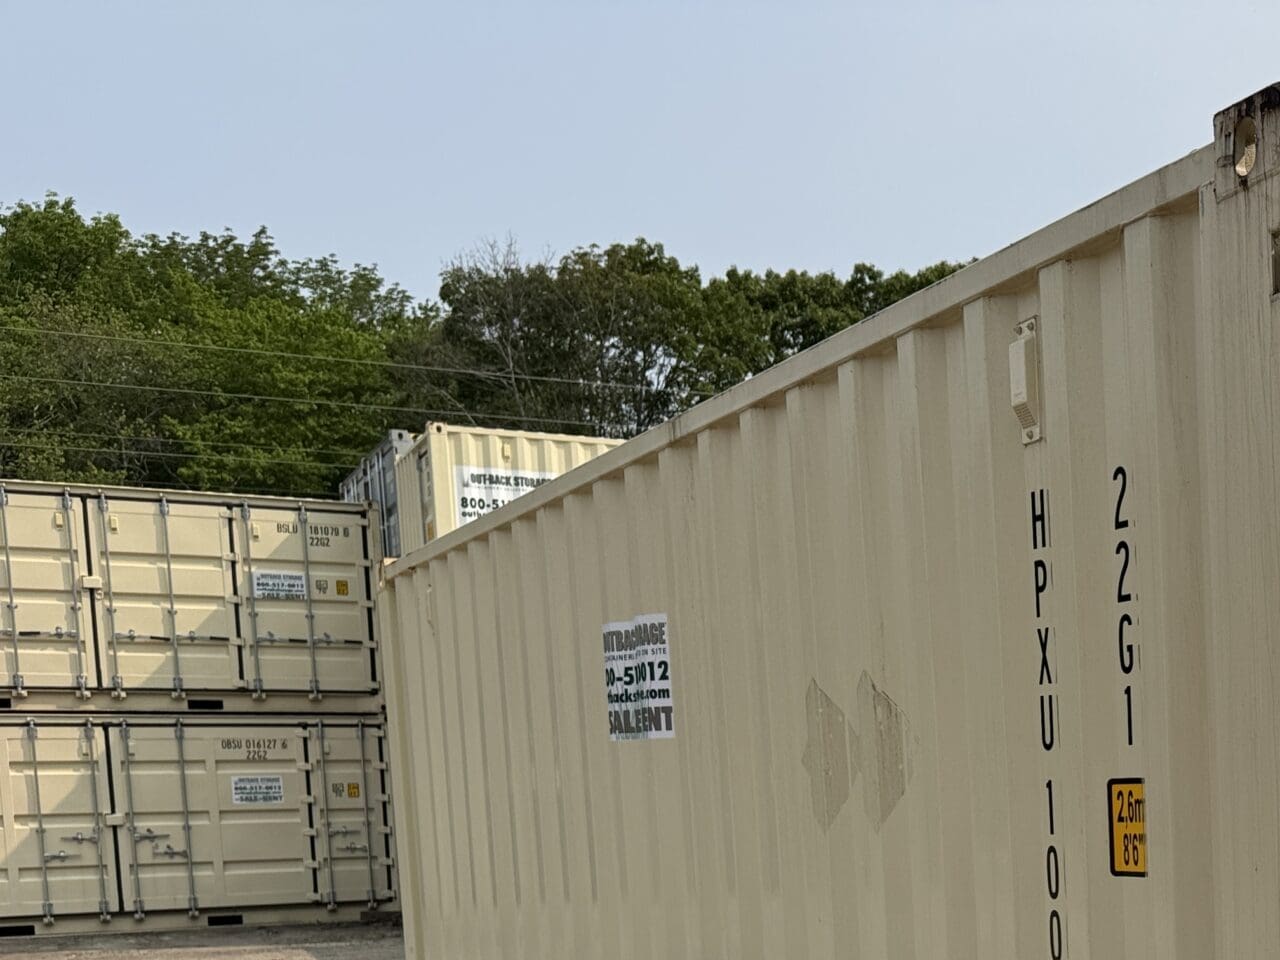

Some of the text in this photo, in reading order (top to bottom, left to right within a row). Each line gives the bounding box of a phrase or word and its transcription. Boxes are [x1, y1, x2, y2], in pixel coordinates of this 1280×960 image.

[460, 497, 512, 509] 800-51
[1031, 489, 1056, 751] HPXU
[1113, 466, 1136, 746] 22G1
